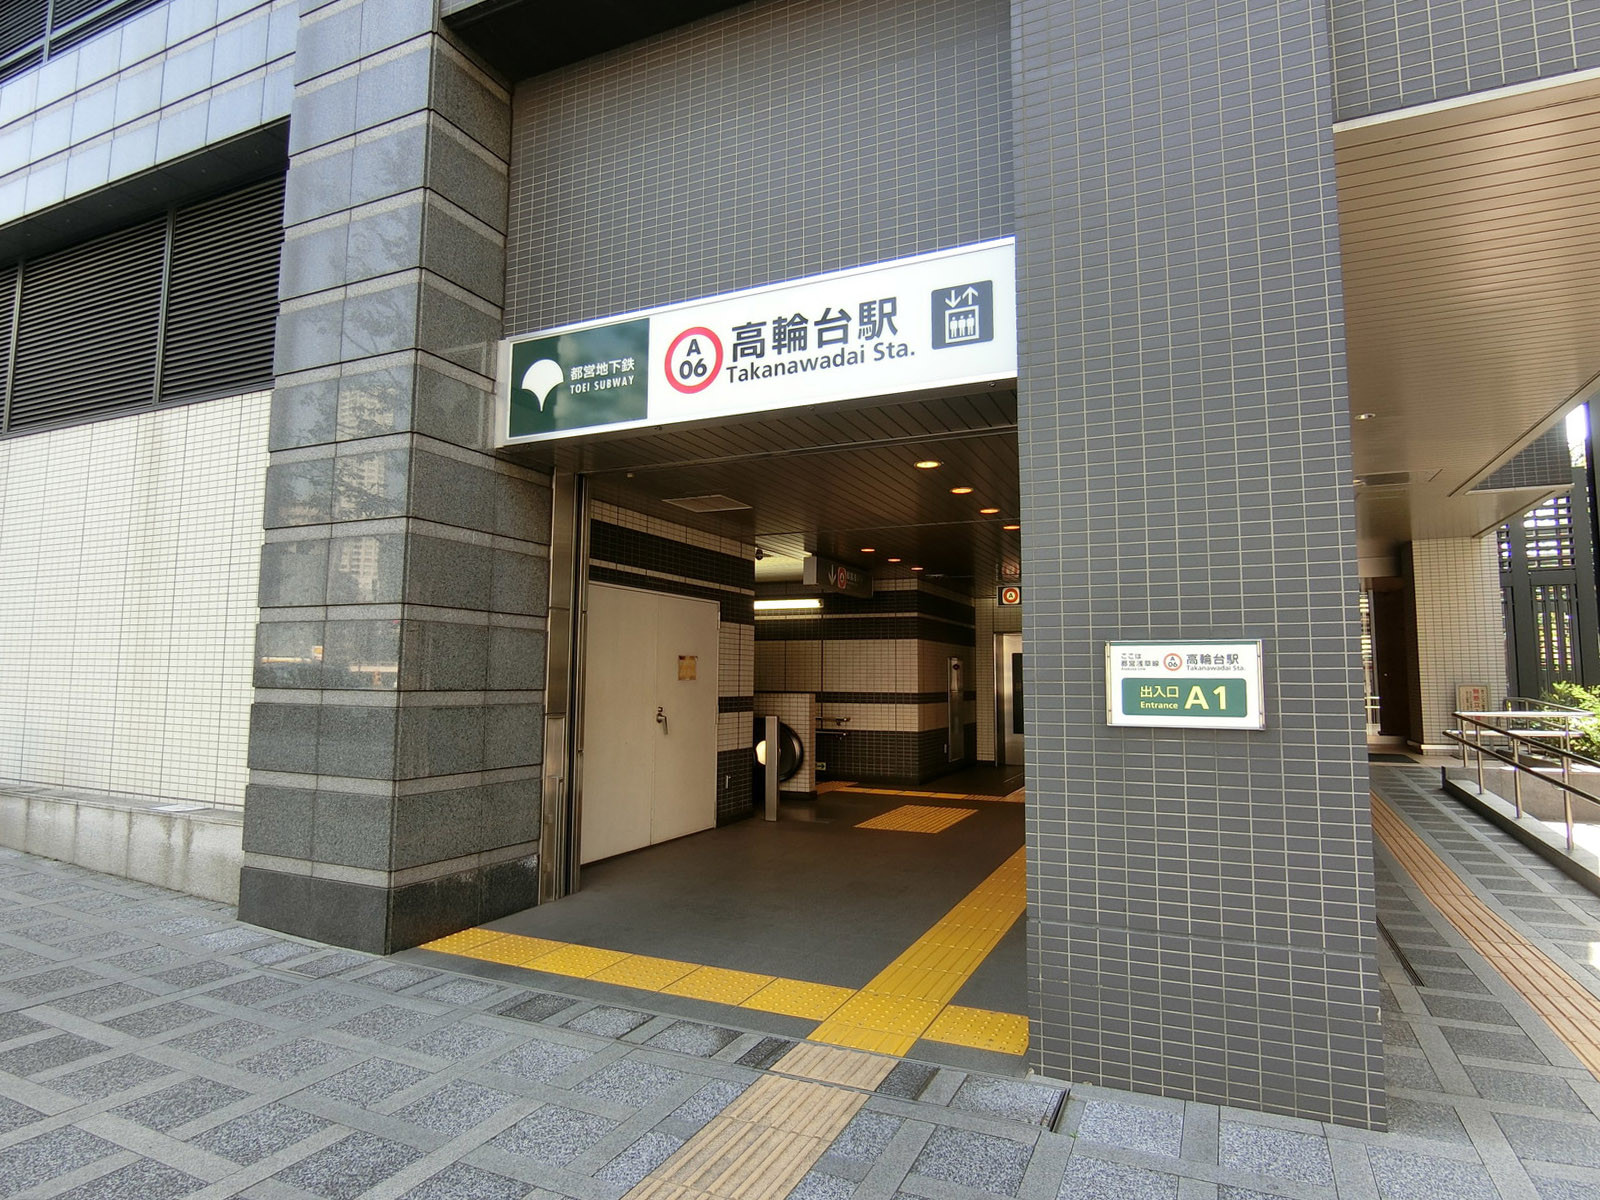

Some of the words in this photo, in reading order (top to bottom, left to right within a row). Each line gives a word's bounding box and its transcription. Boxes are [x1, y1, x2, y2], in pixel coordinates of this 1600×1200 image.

[731, 296, 898, 362] 高輪台駅
[686, 338, 701, 357] A
[570, 357, 635, 380] 都営地下鉄
[679, 358, 708, 379] 06
[726, 345, 865, 383] Takanawadai
[873, 342, 915, 362] Sta.
[570, 383, 590, 395] TOEI
[594, 375, 634, 391] SUBWAY
[1186, 653, 1239, 665] 高輪台駅
[1140, 685, 1179, 698] 出入口
[1184, 685, 1227, 710] A1
[1140, 701, 1179, 710] Entrance
